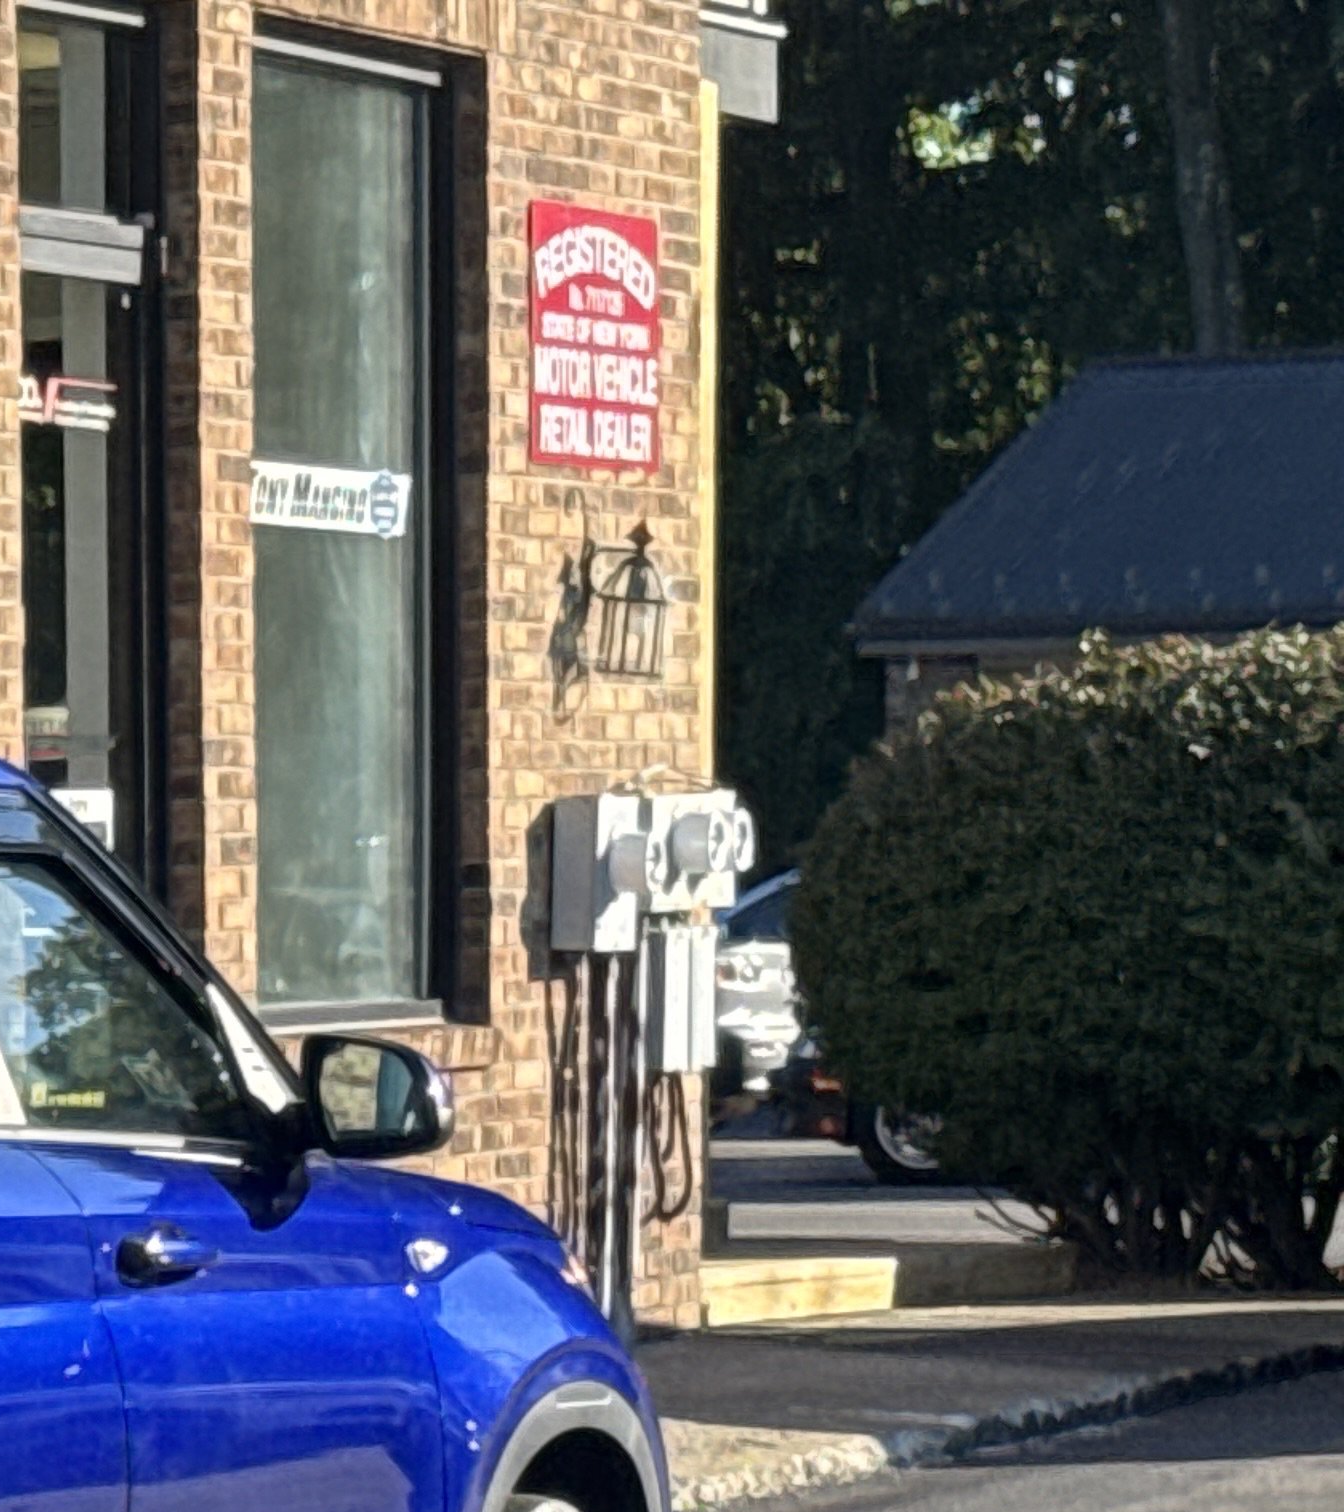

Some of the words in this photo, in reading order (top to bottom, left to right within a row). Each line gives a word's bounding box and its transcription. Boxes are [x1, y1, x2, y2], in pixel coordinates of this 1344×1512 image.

[534, 224, 655, 311] REGISTERED
[535, 343, 592, 399] MOTOR
[593, 354, 657, 408] VEHICLE
[539, 403, 592, 457] RETAIL
[593, 408, 653, 463] DEALER
